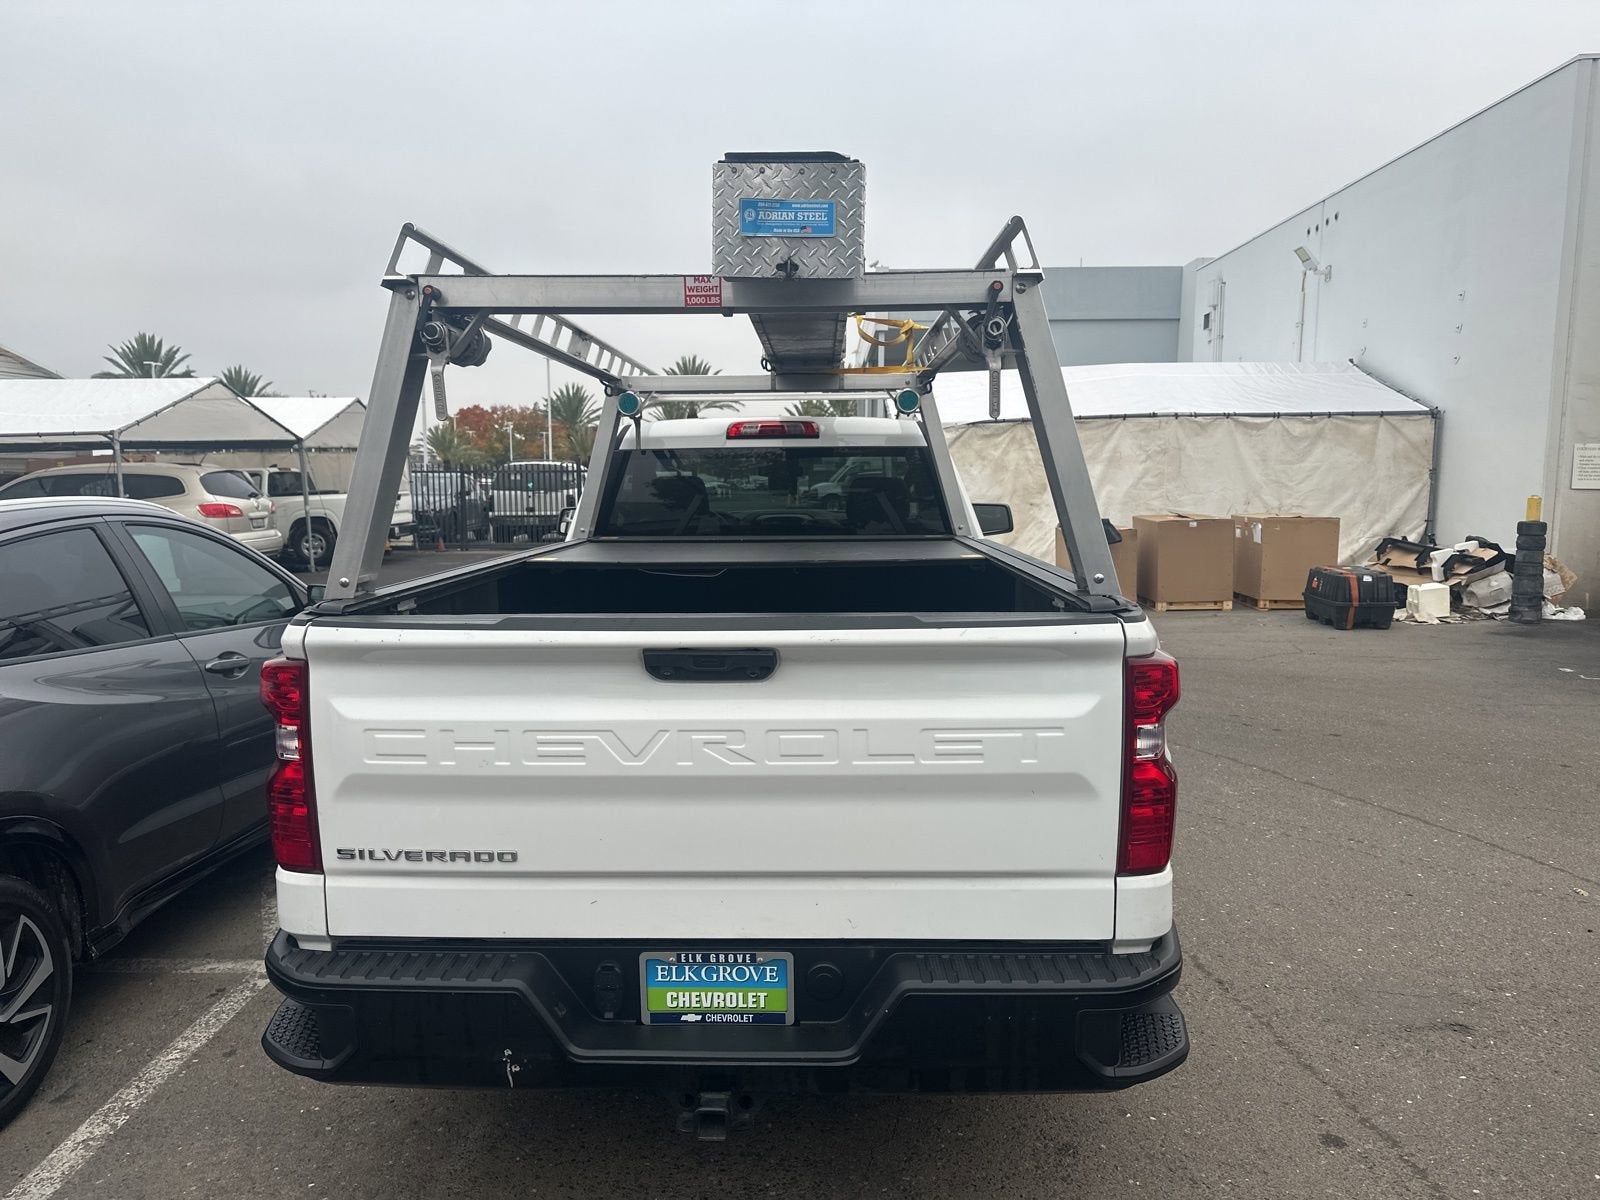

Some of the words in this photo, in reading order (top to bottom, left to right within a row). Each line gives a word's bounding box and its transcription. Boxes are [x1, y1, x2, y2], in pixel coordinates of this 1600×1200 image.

[758, 211, 795, 221] ADRIAN
[797, 211, 828, 221] STEEL
[693, 275, 712, 283] MAX
[687, 285, 719, 293] WEIGHT
[686, 296, 706, 304] 1,000
[706, 296, 721, 304] LBS
[363, 727, 1065, 766] CHEVROLET
[336, 848, 519, 863] SILVERADO
[681, 953, 703, 963] ELK
[710, 953, 752, 963] GROVE
[666, 991, 768, 1009] CHEVROLET
[705, 1013, 754, 1023] CHEVROLET
